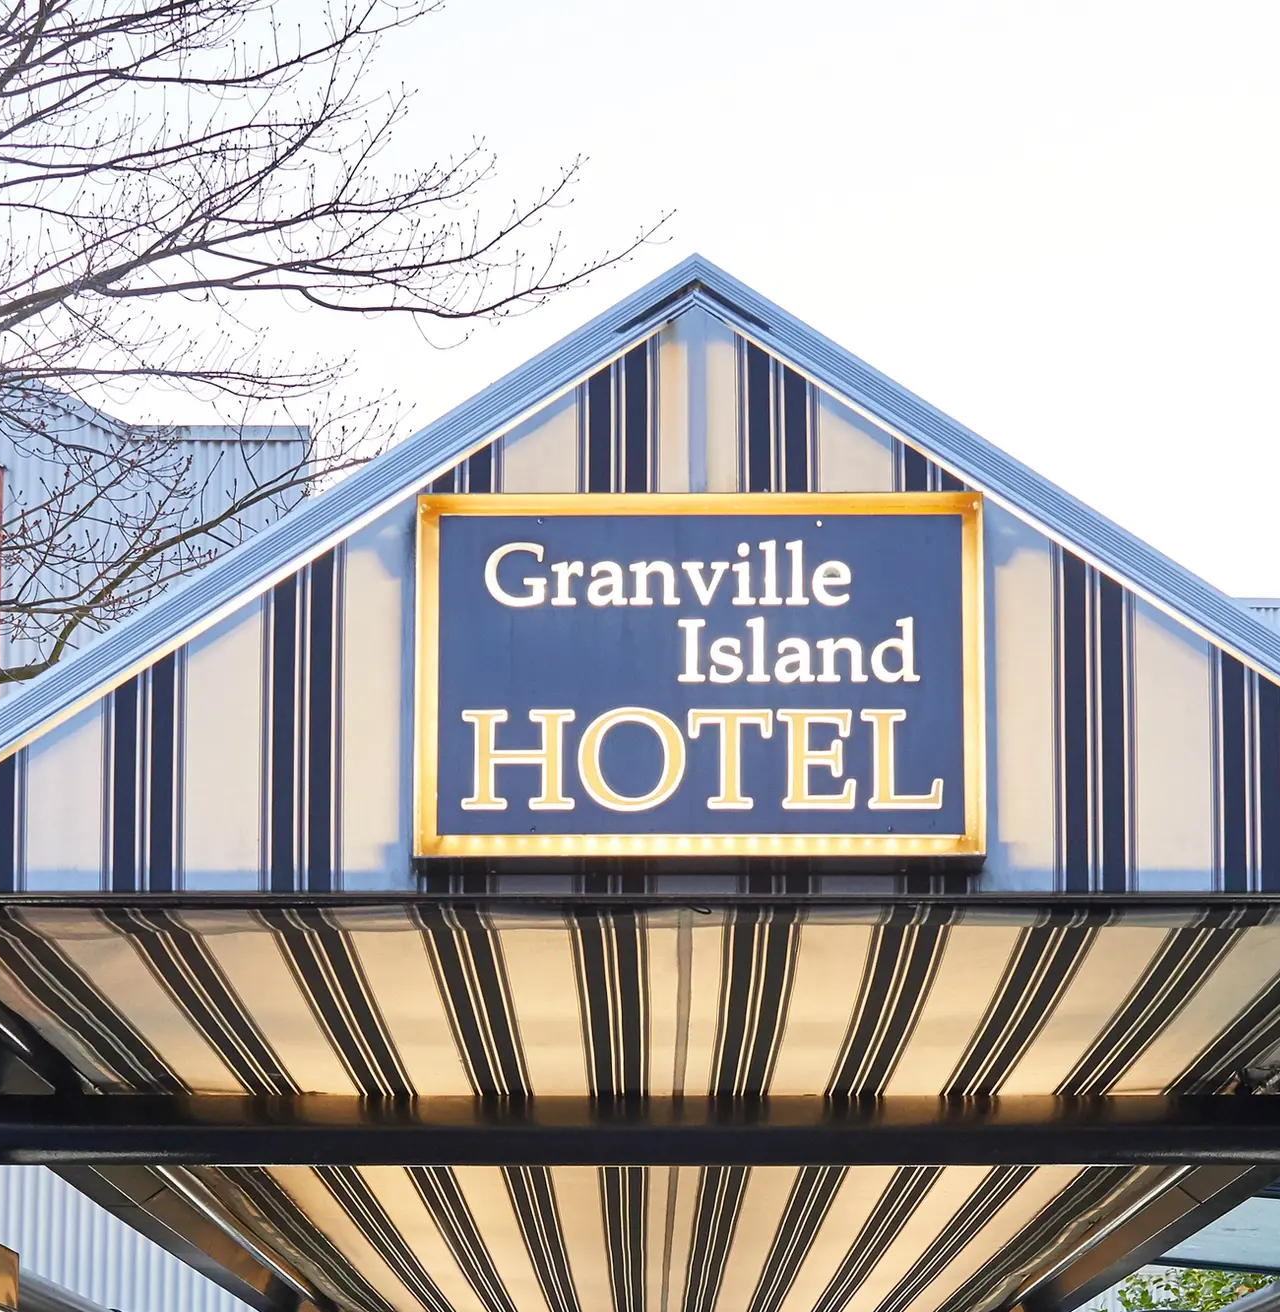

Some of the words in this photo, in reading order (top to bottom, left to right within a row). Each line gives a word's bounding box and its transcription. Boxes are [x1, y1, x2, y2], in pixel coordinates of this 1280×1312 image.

[484, 539, 852, 608] Granville
[677, 616, 921, 684] Island
[460, 706, 944, 812] HOTEL
